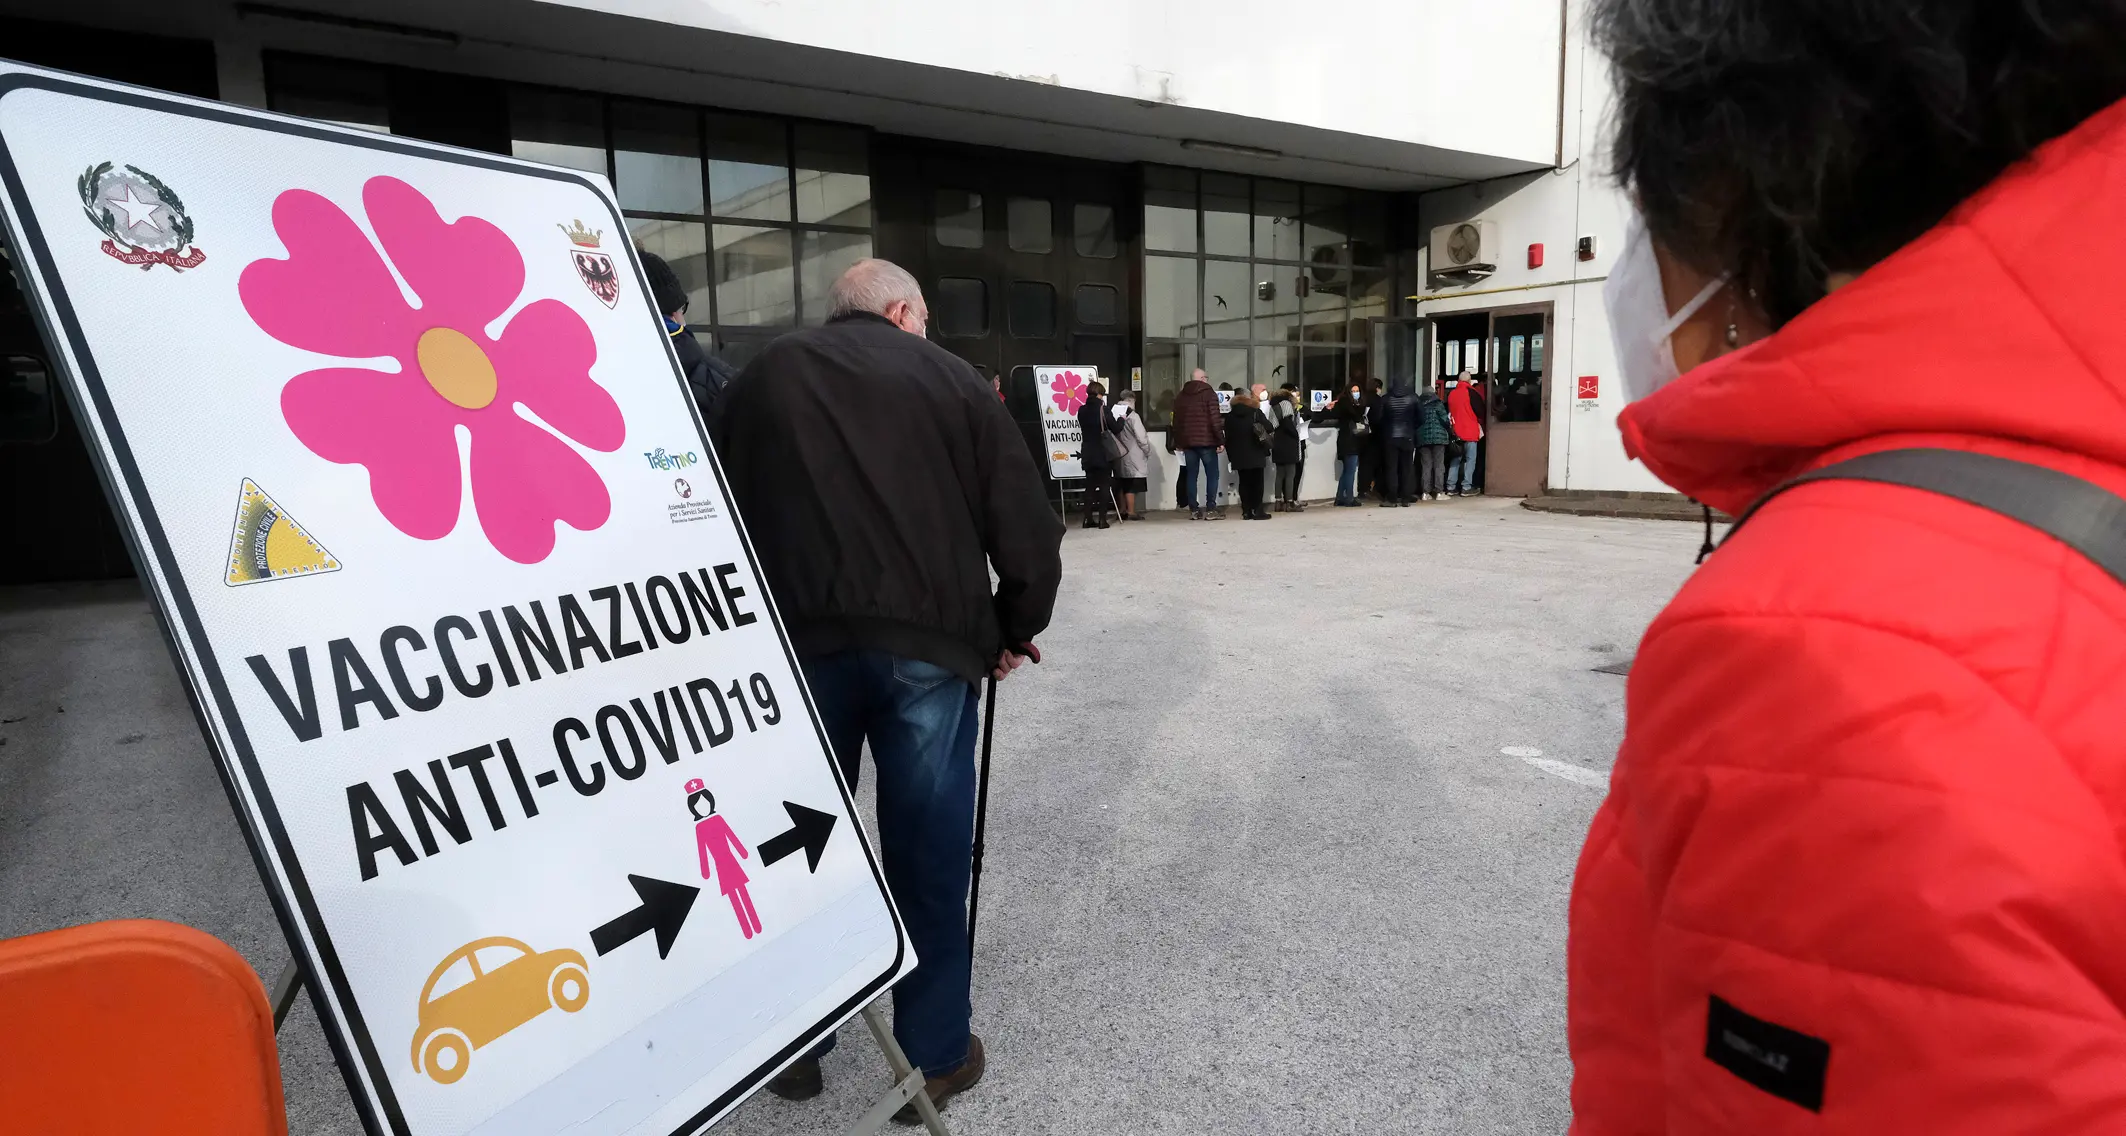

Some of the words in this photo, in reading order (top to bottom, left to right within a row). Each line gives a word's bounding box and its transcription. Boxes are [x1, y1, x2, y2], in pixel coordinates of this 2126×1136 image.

[103, 244, 160, 263] REPVBBLICA
[165, 252, 205, 267] ITALIANA
[1050, 432, 1082, 442] ANTI-CO
[644, 451, 697, 470] TRENTINO
[668, 502, 687, 510] Azienda
[687, 499, 711, 508] Provinciale
[260, 512, 276, 532] CIVILE
[670, 511, 678, 519] per
[255, 528, 268, 570] PROTEZIONE
[272, 564, 329, 577] TRENTO
[245, 562, 757, 742] VACCINAZIONE
[345, 672, 782, 882] ANTI-COVID19
